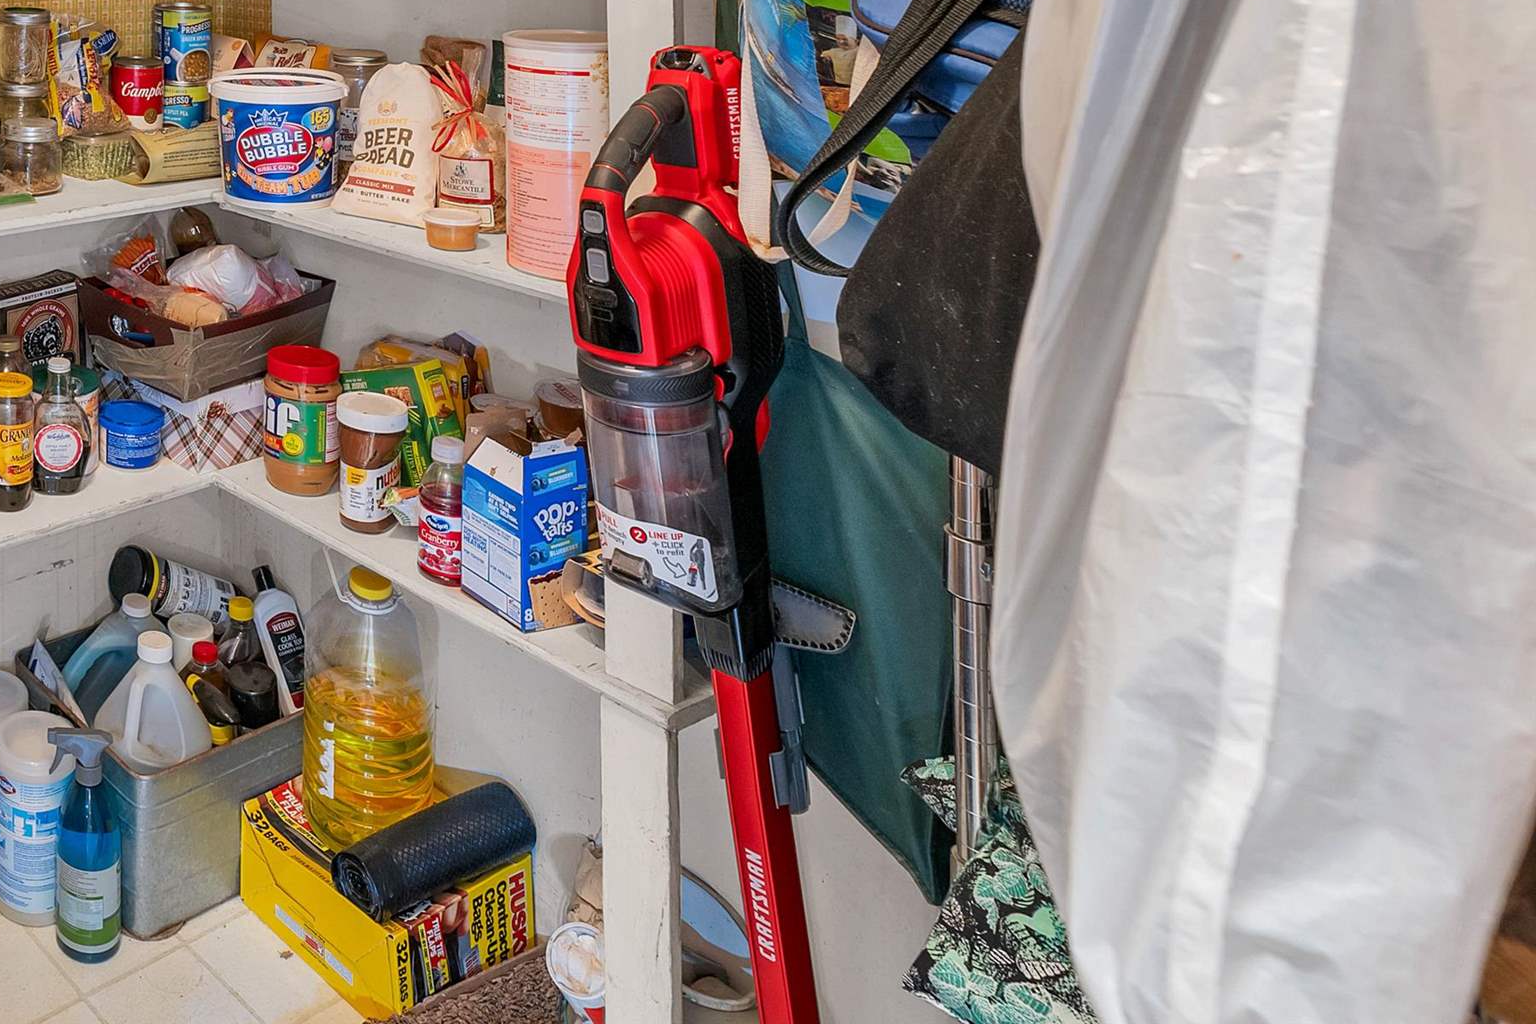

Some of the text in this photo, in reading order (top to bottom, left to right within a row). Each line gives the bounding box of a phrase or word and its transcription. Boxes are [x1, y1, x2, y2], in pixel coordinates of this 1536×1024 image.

[728, 87, 740, 160] CRAFTSMAN
[240, 130, 303, 150] DUBBLE
[365, 127, 414, 149] BEER
[245, 142, 307, 163] BUBBLE
[277, 164, 295, 172] GUM
[255, 177, 288, 194] TEAM
[356, 178, 394, 191] CLASSIC MIX
[442, 181, 486, 195] MERCANTILE
[450, 175, 474, 187] STOWE
[360, 190, 410, 204] BUTTER BAKE
[31, 304, 48, 316] WHOLE
[266, 396, 300, 437] if
[421, 528, 459, 550] Cranberry
[649, 530, 668, 539] LINE
[661, 541, 684, 549] CLICK
[524, 608, 533, 622] 8
[271, 619, 296, 632] WEIMAN
[280, 633, 298, 643] GLASS
[250, 810, 290, 853] 32 BAGS
[745, 848, 776, 963] CRAFTSMAN
[471, 894, 483, 942] Bags
[432, 917, 441, 941] TRUE
[397, 940, 409, 1002] 32 BAGS
